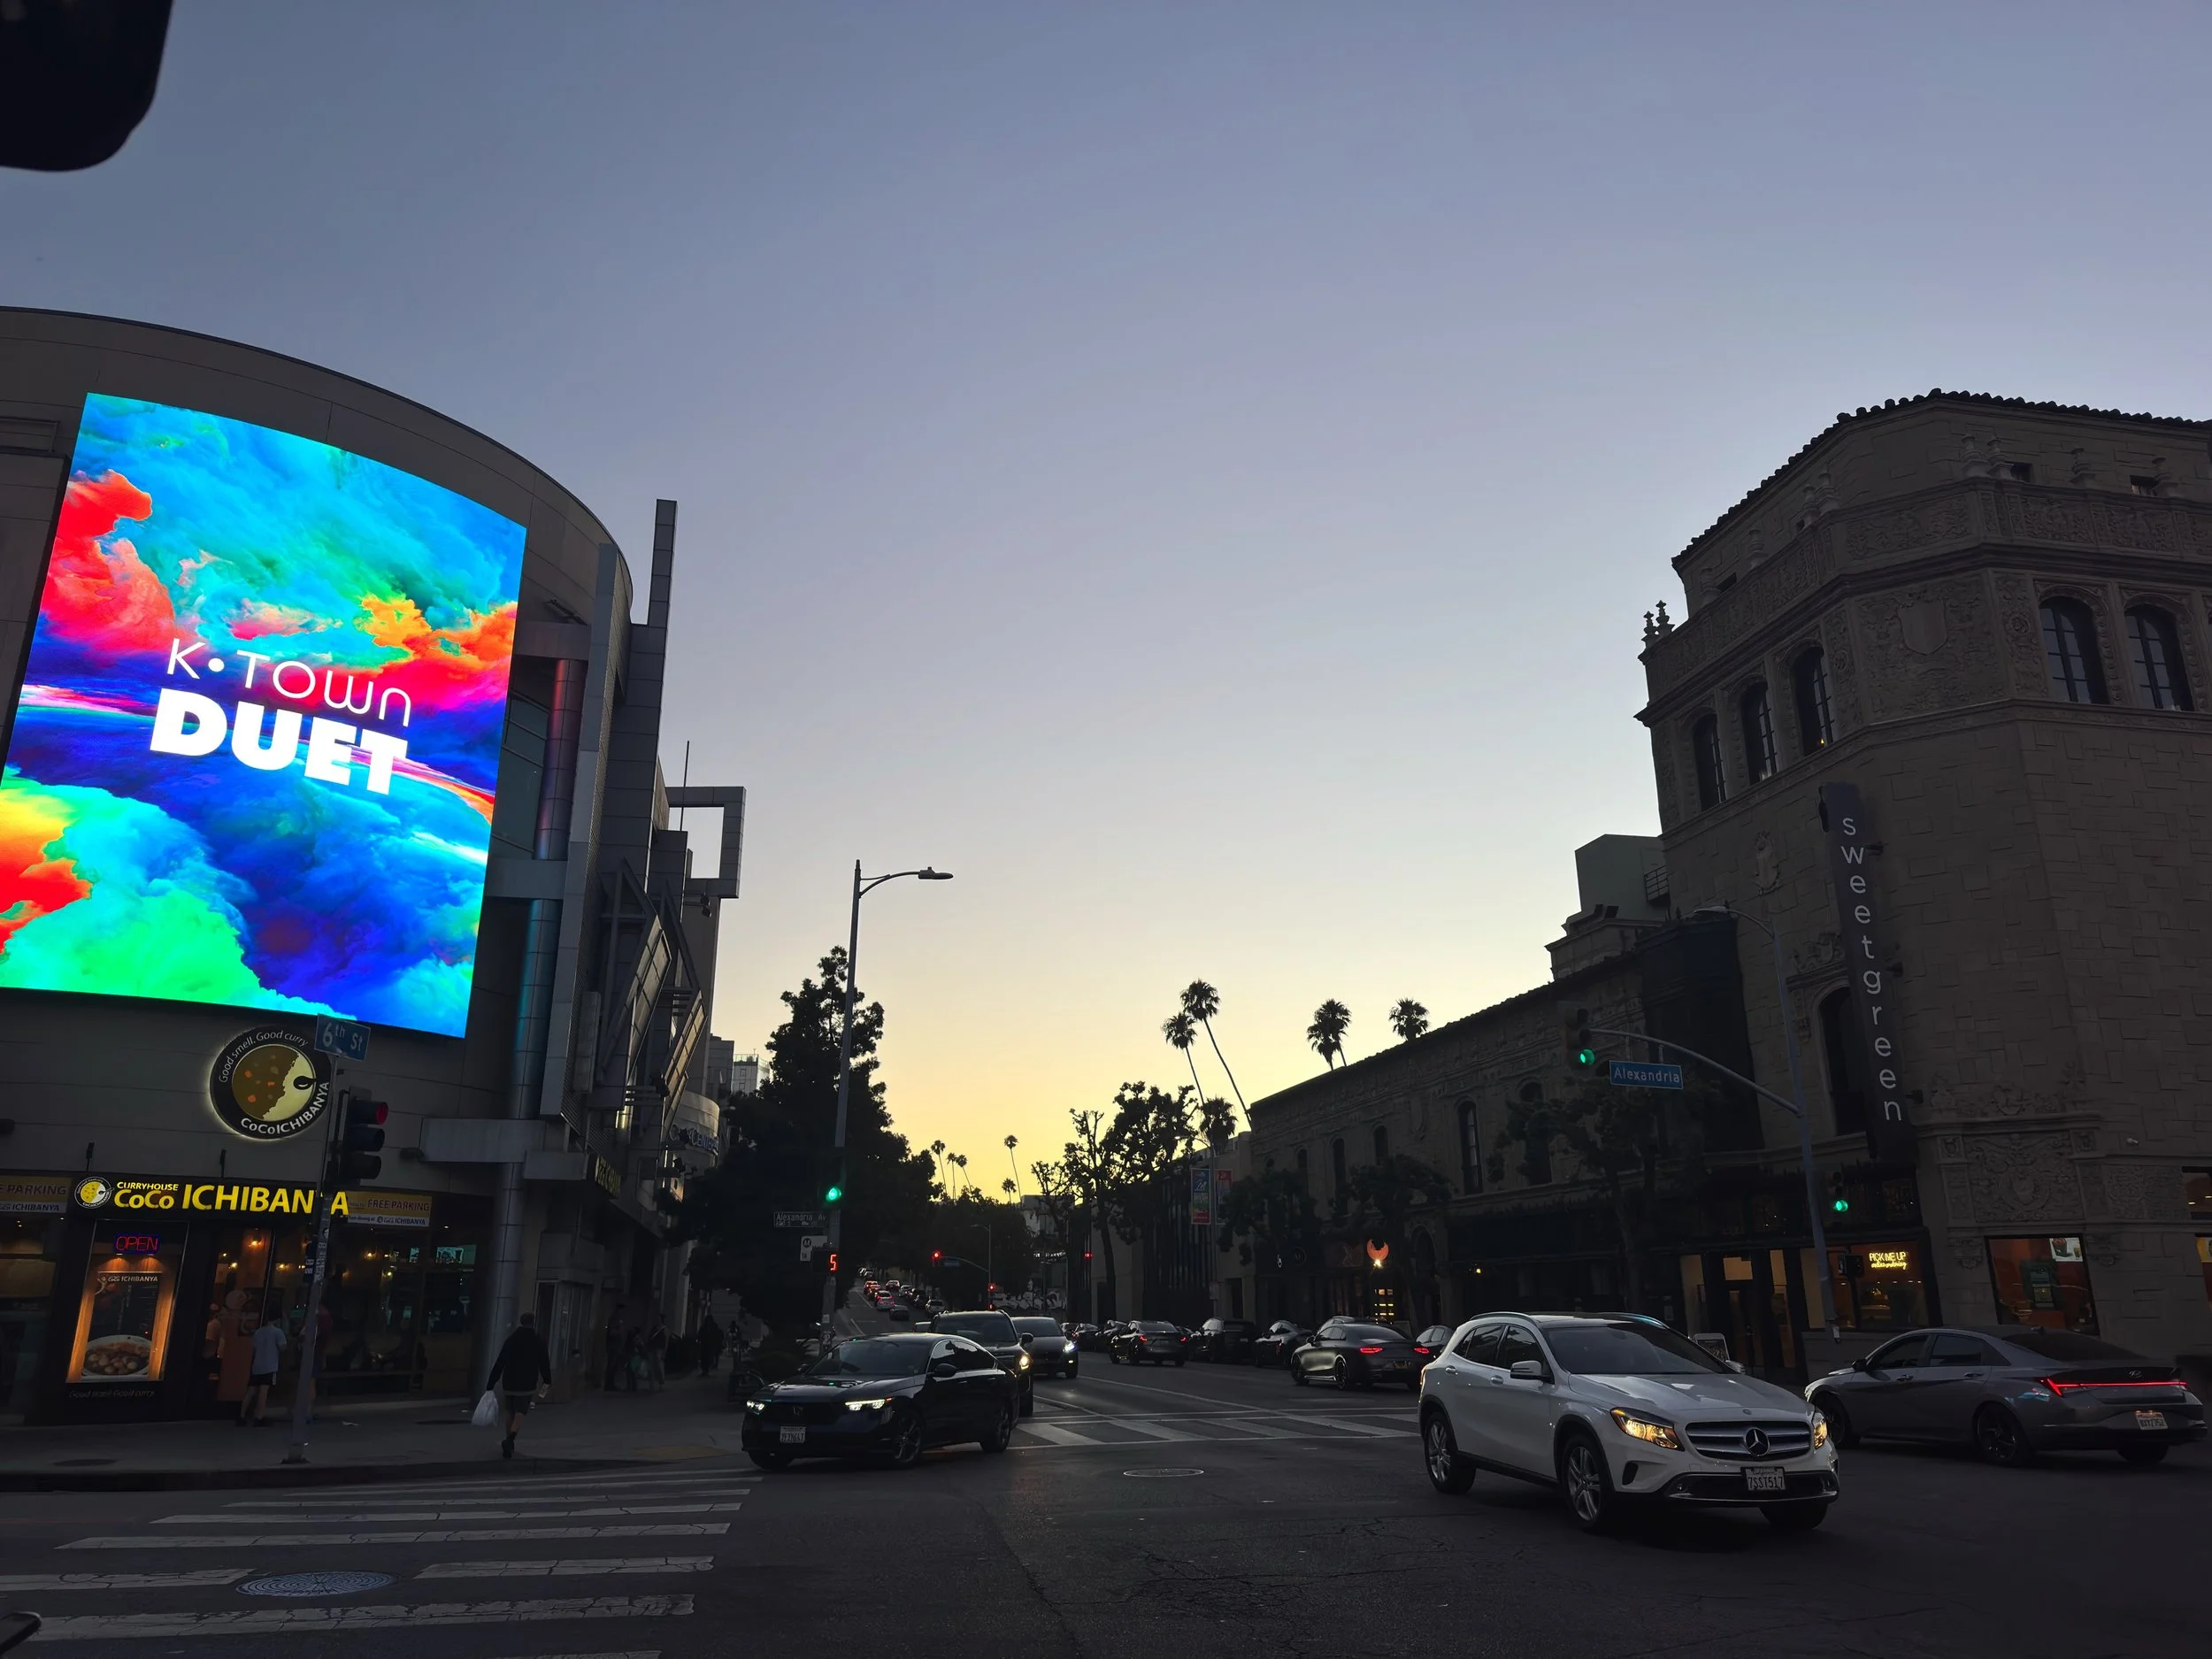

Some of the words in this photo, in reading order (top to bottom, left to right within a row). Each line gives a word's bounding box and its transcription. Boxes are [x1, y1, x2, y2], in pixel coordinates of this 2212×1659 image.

[150, 687, 409, 795] DUET
[1840, 817, 1902, 1122] sweetgreen
[322, 1022, 345, 1048] 6th
[349, 1033, 364, 1051] St
[219, 1056, 234, 1083] Good
[256, 1030, 284, 1041] Good
[284, 1033, 309, 1047] curry
[1613, 1066, 1679, 1084] Alexandria
[7, 1184, 66, 1195] PARKING
[117, 1181, 179, 1191] CURRYHOUSE
[113, 1189, 175, 1210] CoCo
[181, 1184, 349, 1216] ICHIBANA
[367, 1199, 390, 1209] FREE
[391, 1200, 430, 1211] PARKING
[776, 1212, 813, 1221] Alexandria
[116, 1235, 158, 1251] OPEN
[830, 1254, 837, 1271] 5
[1896, 1251, 1907, 1261] UP
